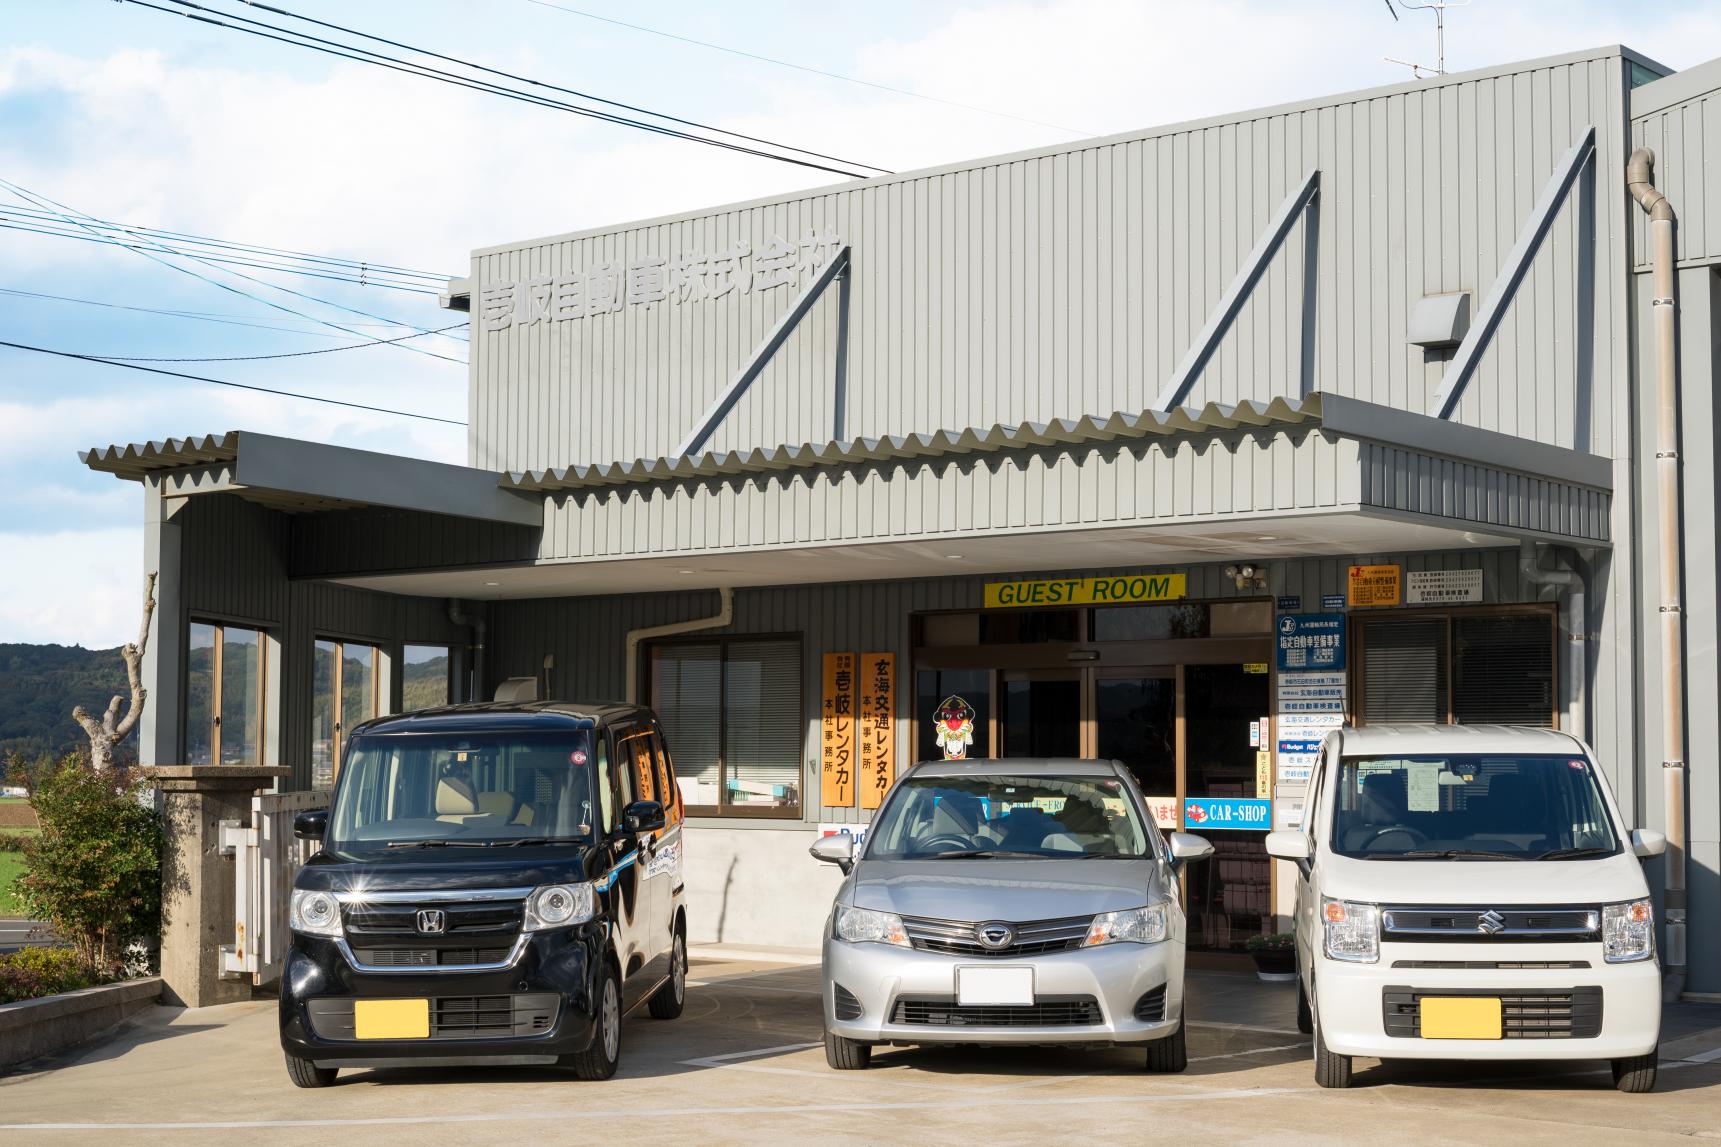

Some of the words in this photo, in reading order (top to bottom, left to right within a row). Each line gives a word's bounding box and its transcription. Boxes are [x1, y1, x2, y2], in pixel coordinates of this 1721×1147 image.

[1092, 577, 1170, 601] ROOM
[824, 699, 833, 772] 本社事務所
[835, 670, 851, 802] 壱岐レンタカー
[862, 695, 872, 770] 本社事務所
[874, 659, 889, 802] 玄海交通レンタカー
[1209, 804, 1267, 822] CAR-SHOP
